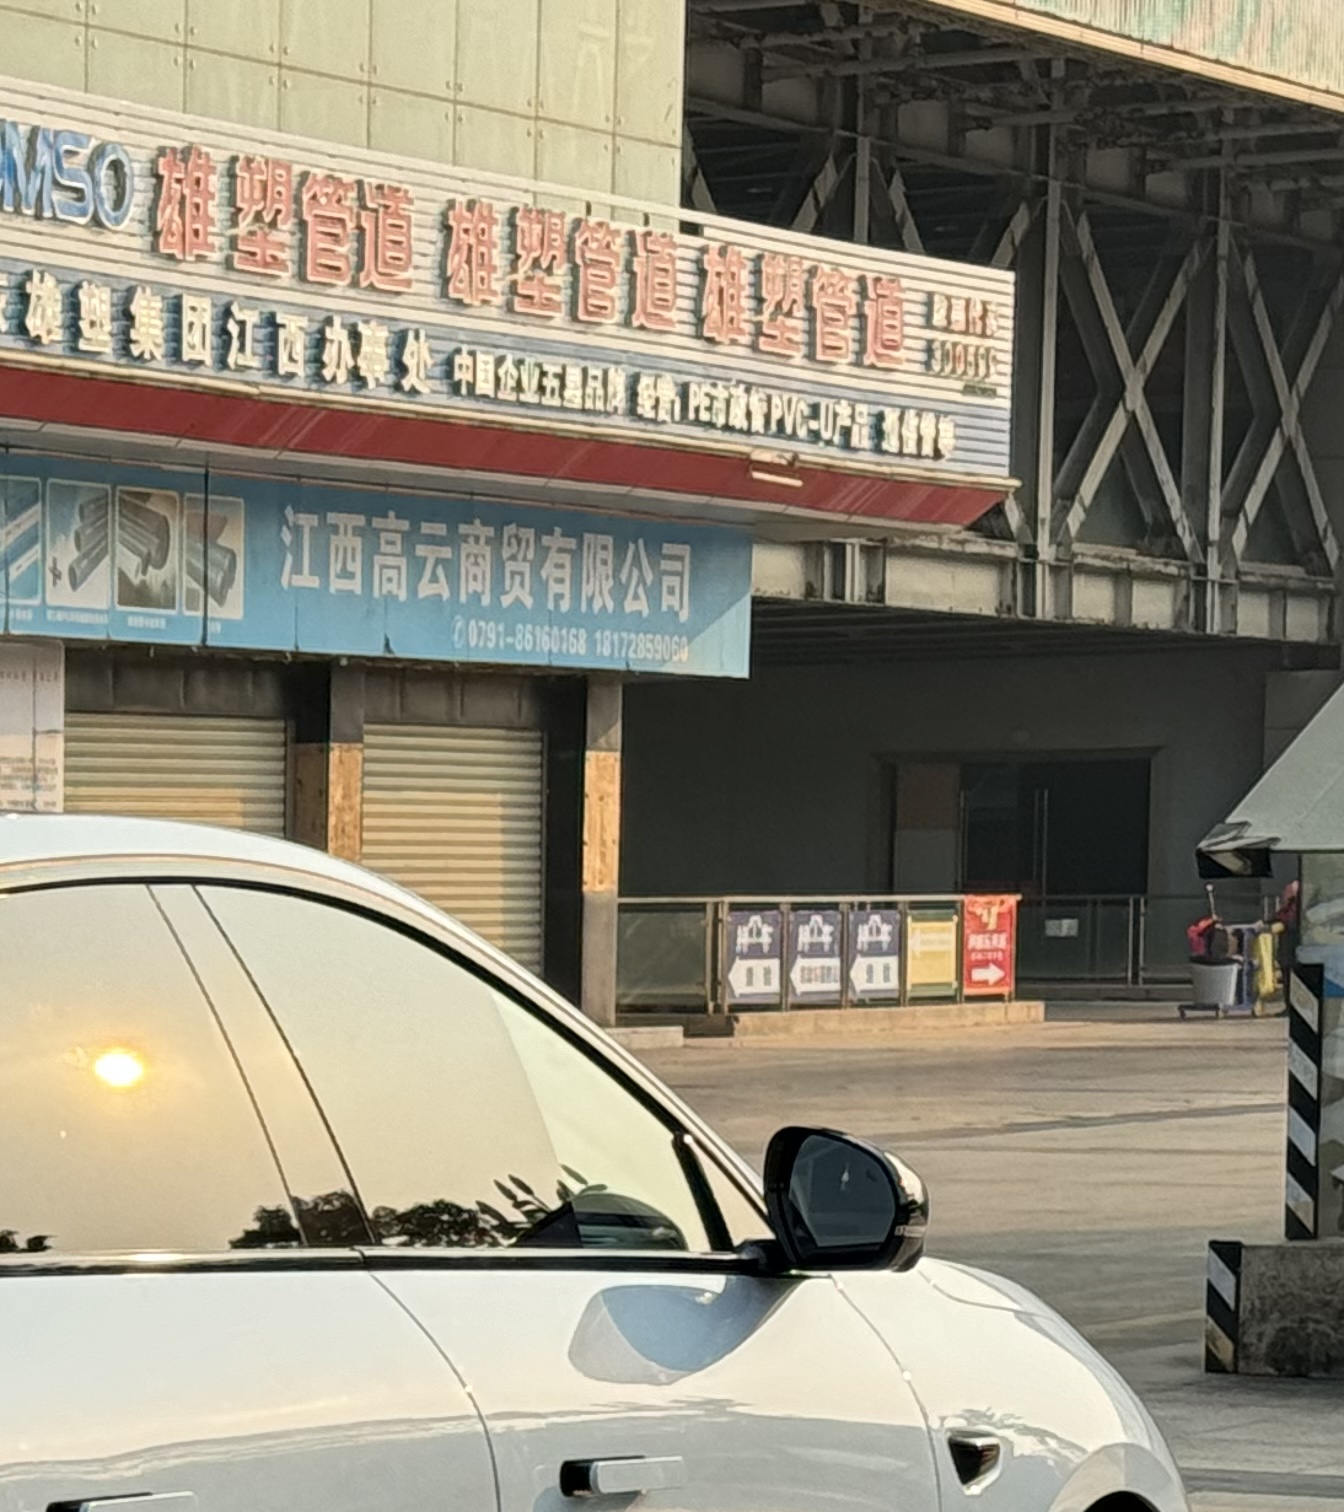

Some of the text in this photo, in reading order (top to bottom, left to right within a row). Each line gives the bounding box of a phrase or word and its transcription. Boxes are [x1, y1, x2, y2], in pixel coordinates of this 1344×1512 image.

[155, 145, 906, 367] 雄塑管道 雄塑管道 雄塑管道
[280, 503, 692, 624] 江西高云商贸有限公司
